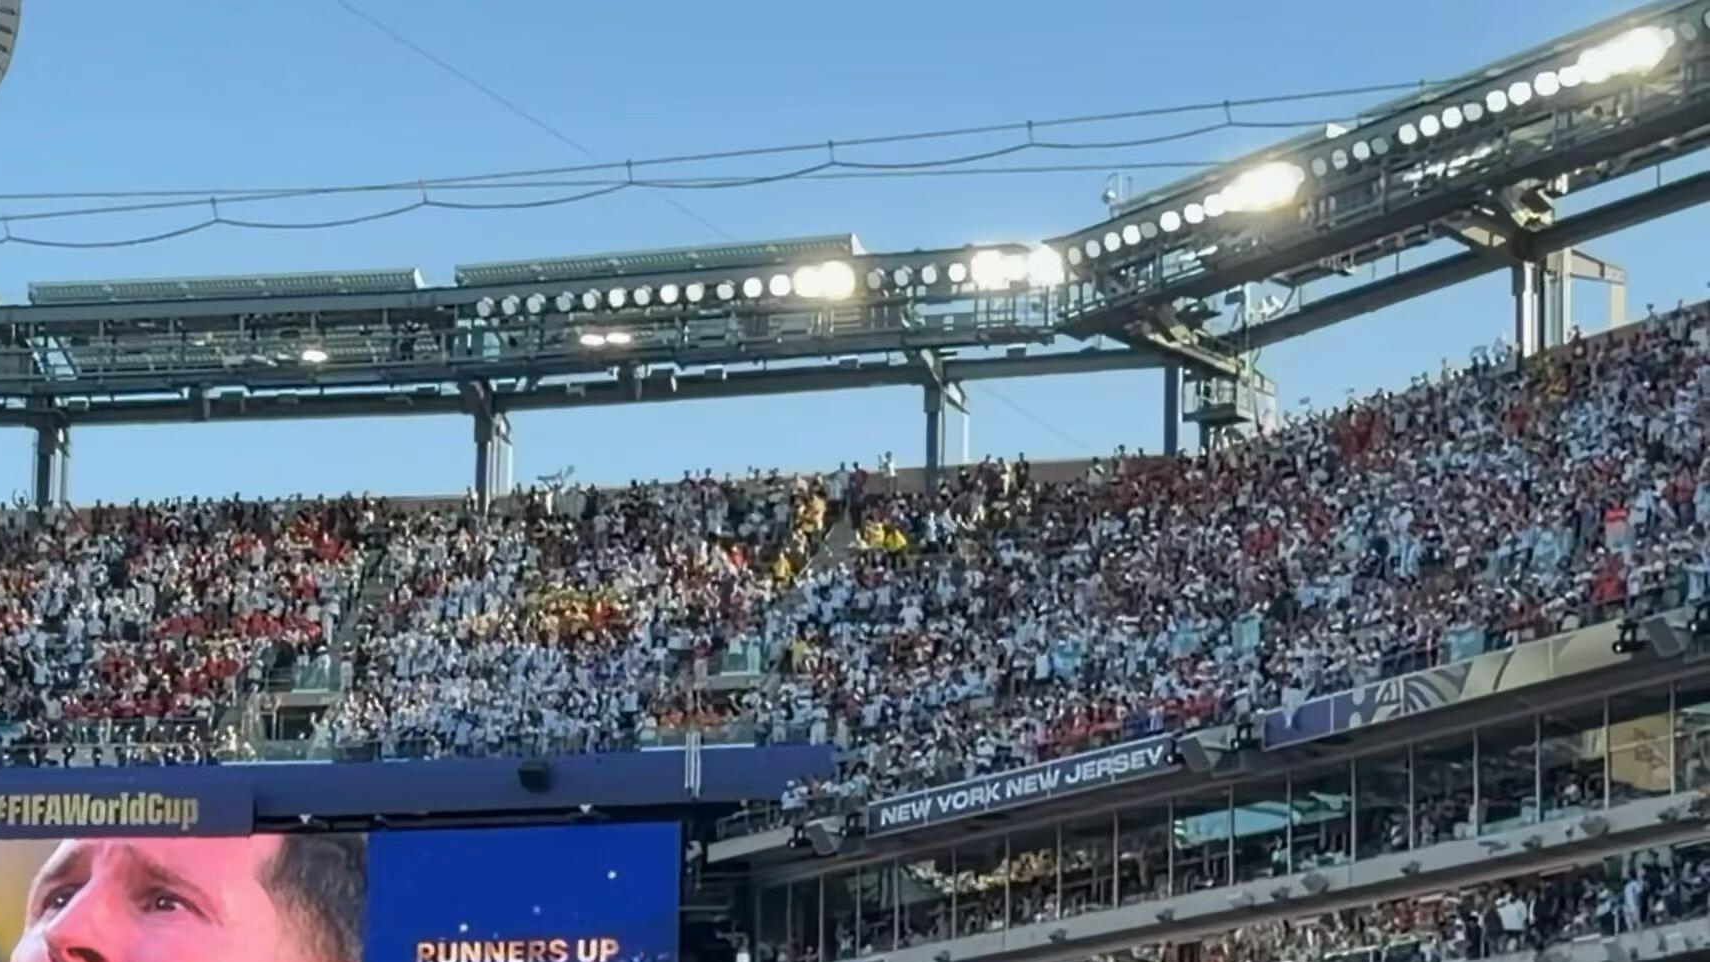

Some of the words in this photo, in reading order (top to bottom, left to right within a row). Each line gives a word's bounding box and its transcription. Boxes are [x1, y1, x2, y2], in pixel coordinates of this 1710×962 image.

[880, 798, 933, 827] NEW
[936, 782, 1001, 814] YORK
[1005, 769, 1061, 798] NEW
[1064, 745, 1164, 784] JERSEY
